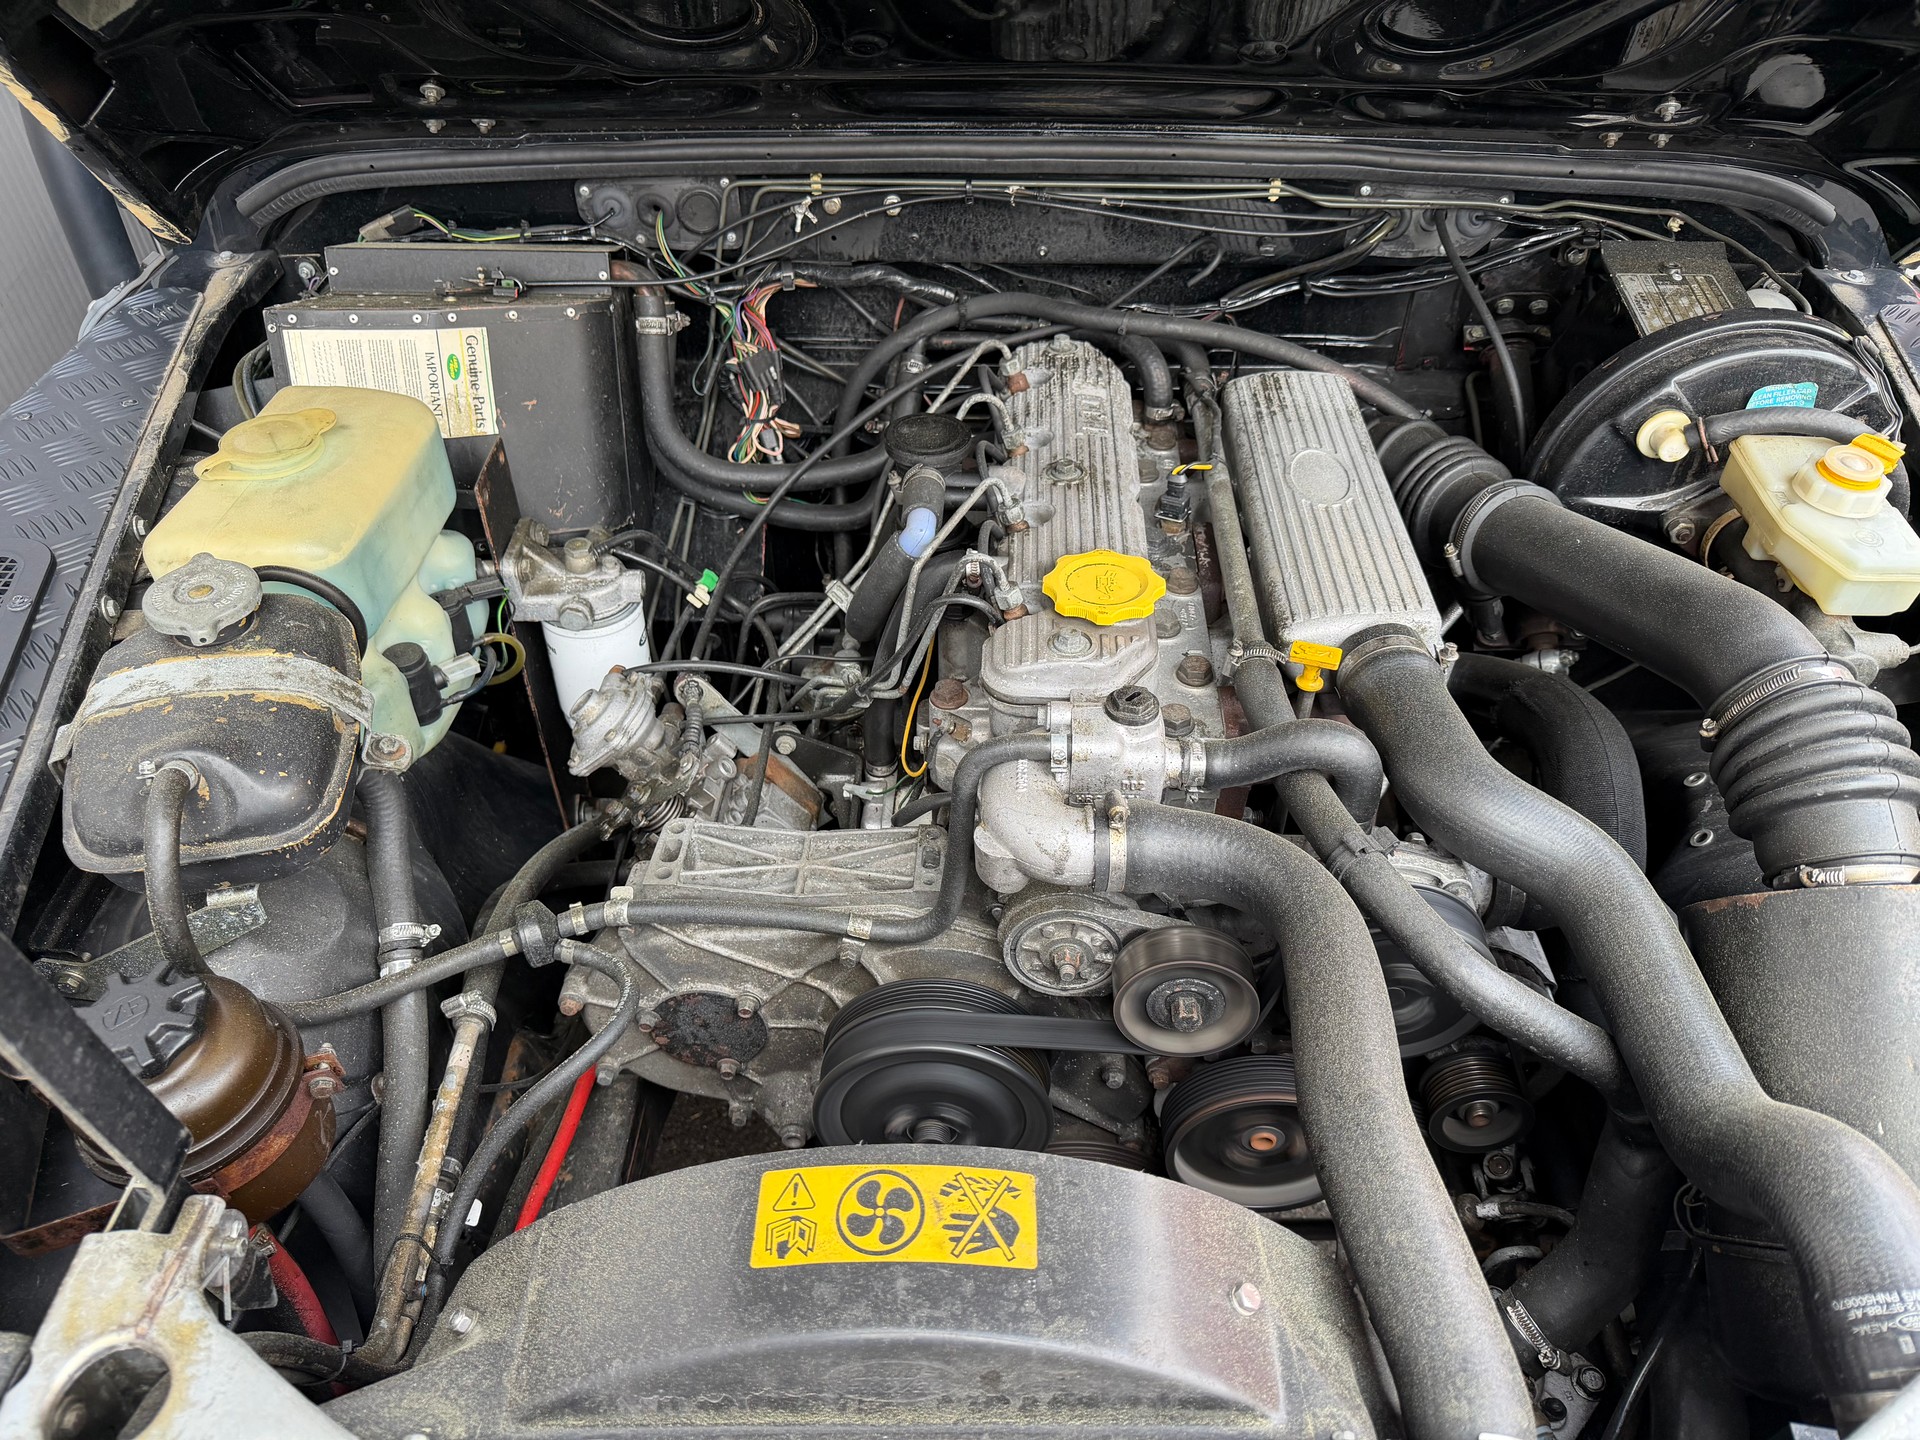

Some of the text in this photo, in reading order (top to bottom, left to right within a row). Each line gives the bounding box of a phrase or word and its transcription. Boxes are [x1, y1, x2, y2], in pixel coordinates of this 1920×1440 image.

[424, 352, 443, 419] IMPORTANT
[465, 335, 487, 429] Genuine Parts
[1773, 389, 1796, 397] FILLER
[1775, 394, 1812, 403] REMOVING
[103, 994, 147, 1031] ZF
